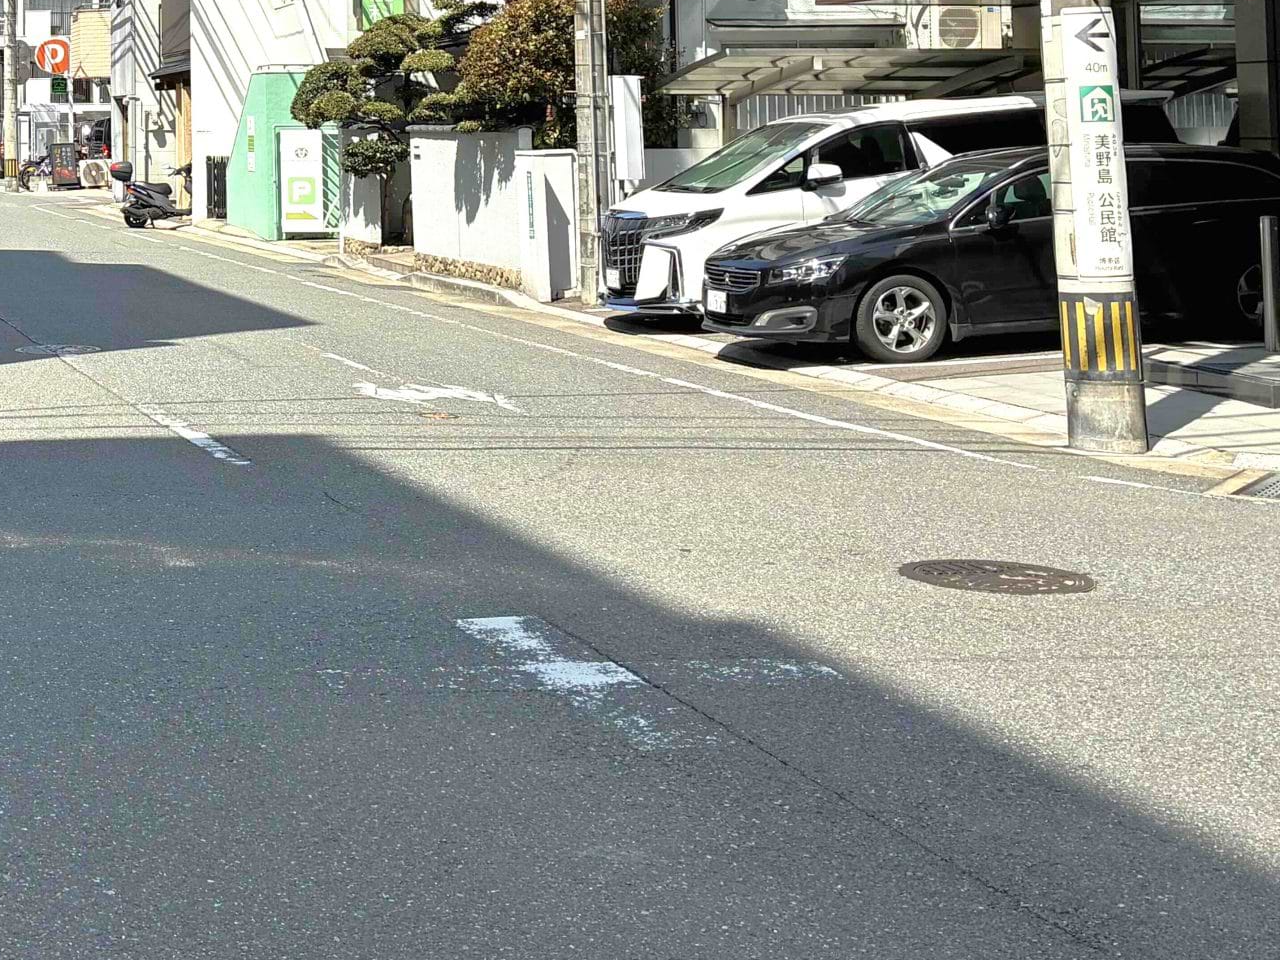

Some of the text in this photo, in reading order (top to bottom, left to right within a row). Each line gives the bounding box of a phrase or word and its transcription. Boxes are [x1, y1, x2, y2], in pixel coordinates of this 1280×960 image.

[44, 43, 65, 73] P
[1085, 62, 1108, 73] 40m
[292, 180, 312, 202] P
[1094, 133, 1117, 243] 美野島 公民館
